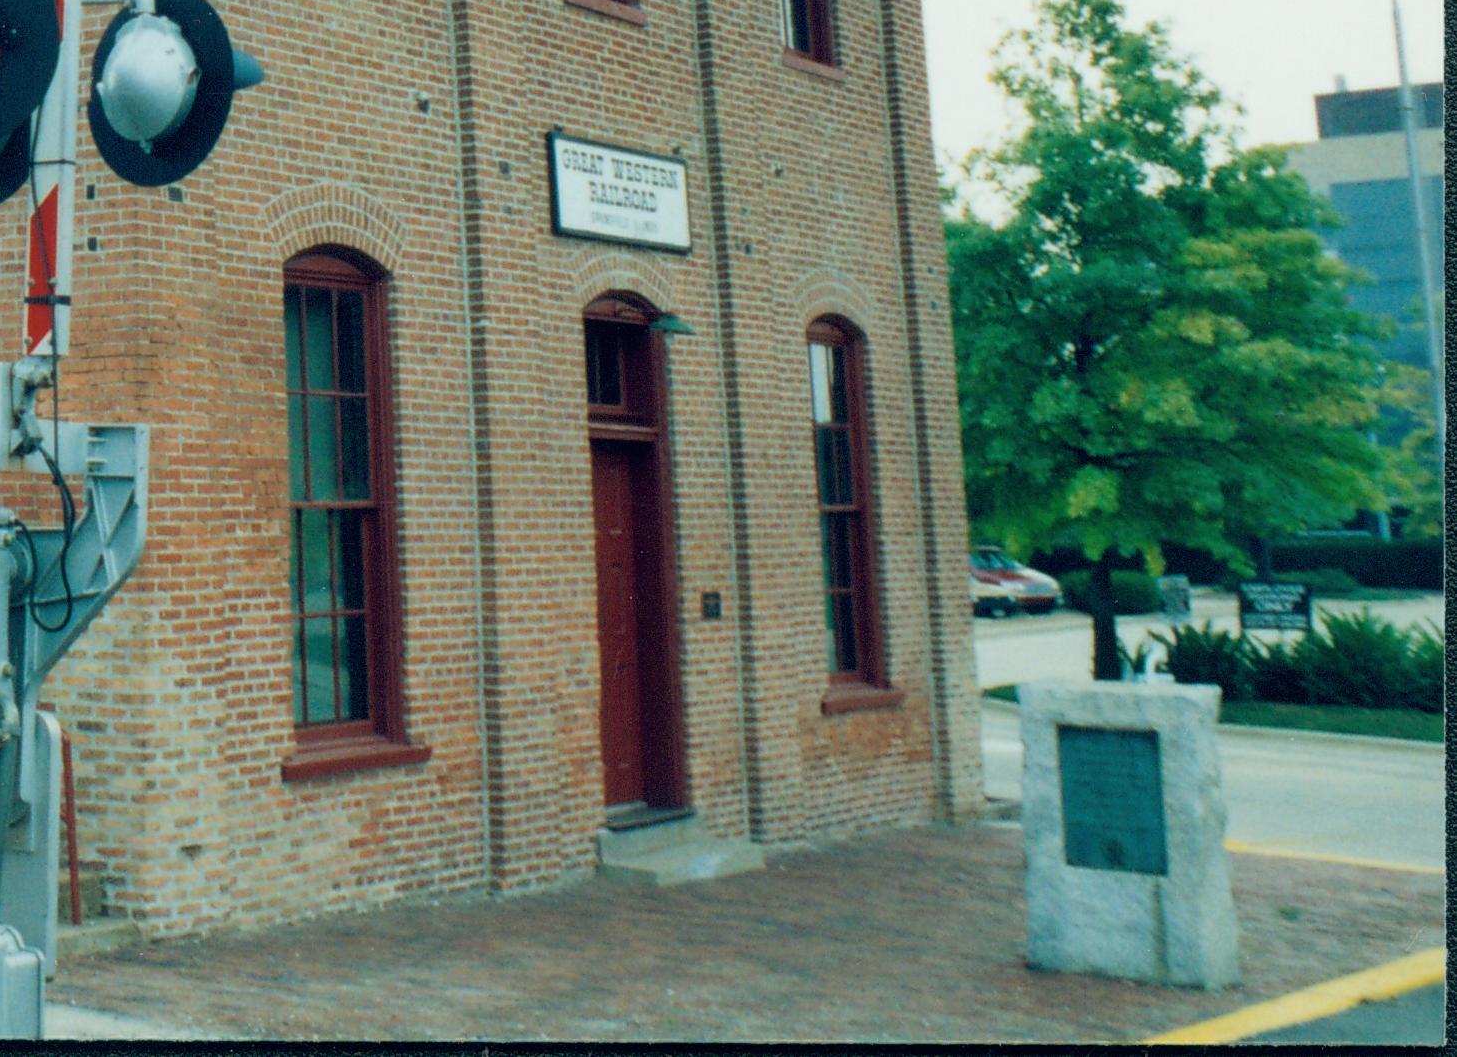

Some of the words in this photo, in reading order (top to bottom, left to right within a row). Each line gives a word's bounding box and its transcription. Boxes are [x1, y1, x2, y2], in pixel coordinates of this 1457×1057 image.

[562, 148, 604, 176] GREAT
[611, 158, 678, 190] WESTERN
[588, 181, 657, 213] RAILROAD
